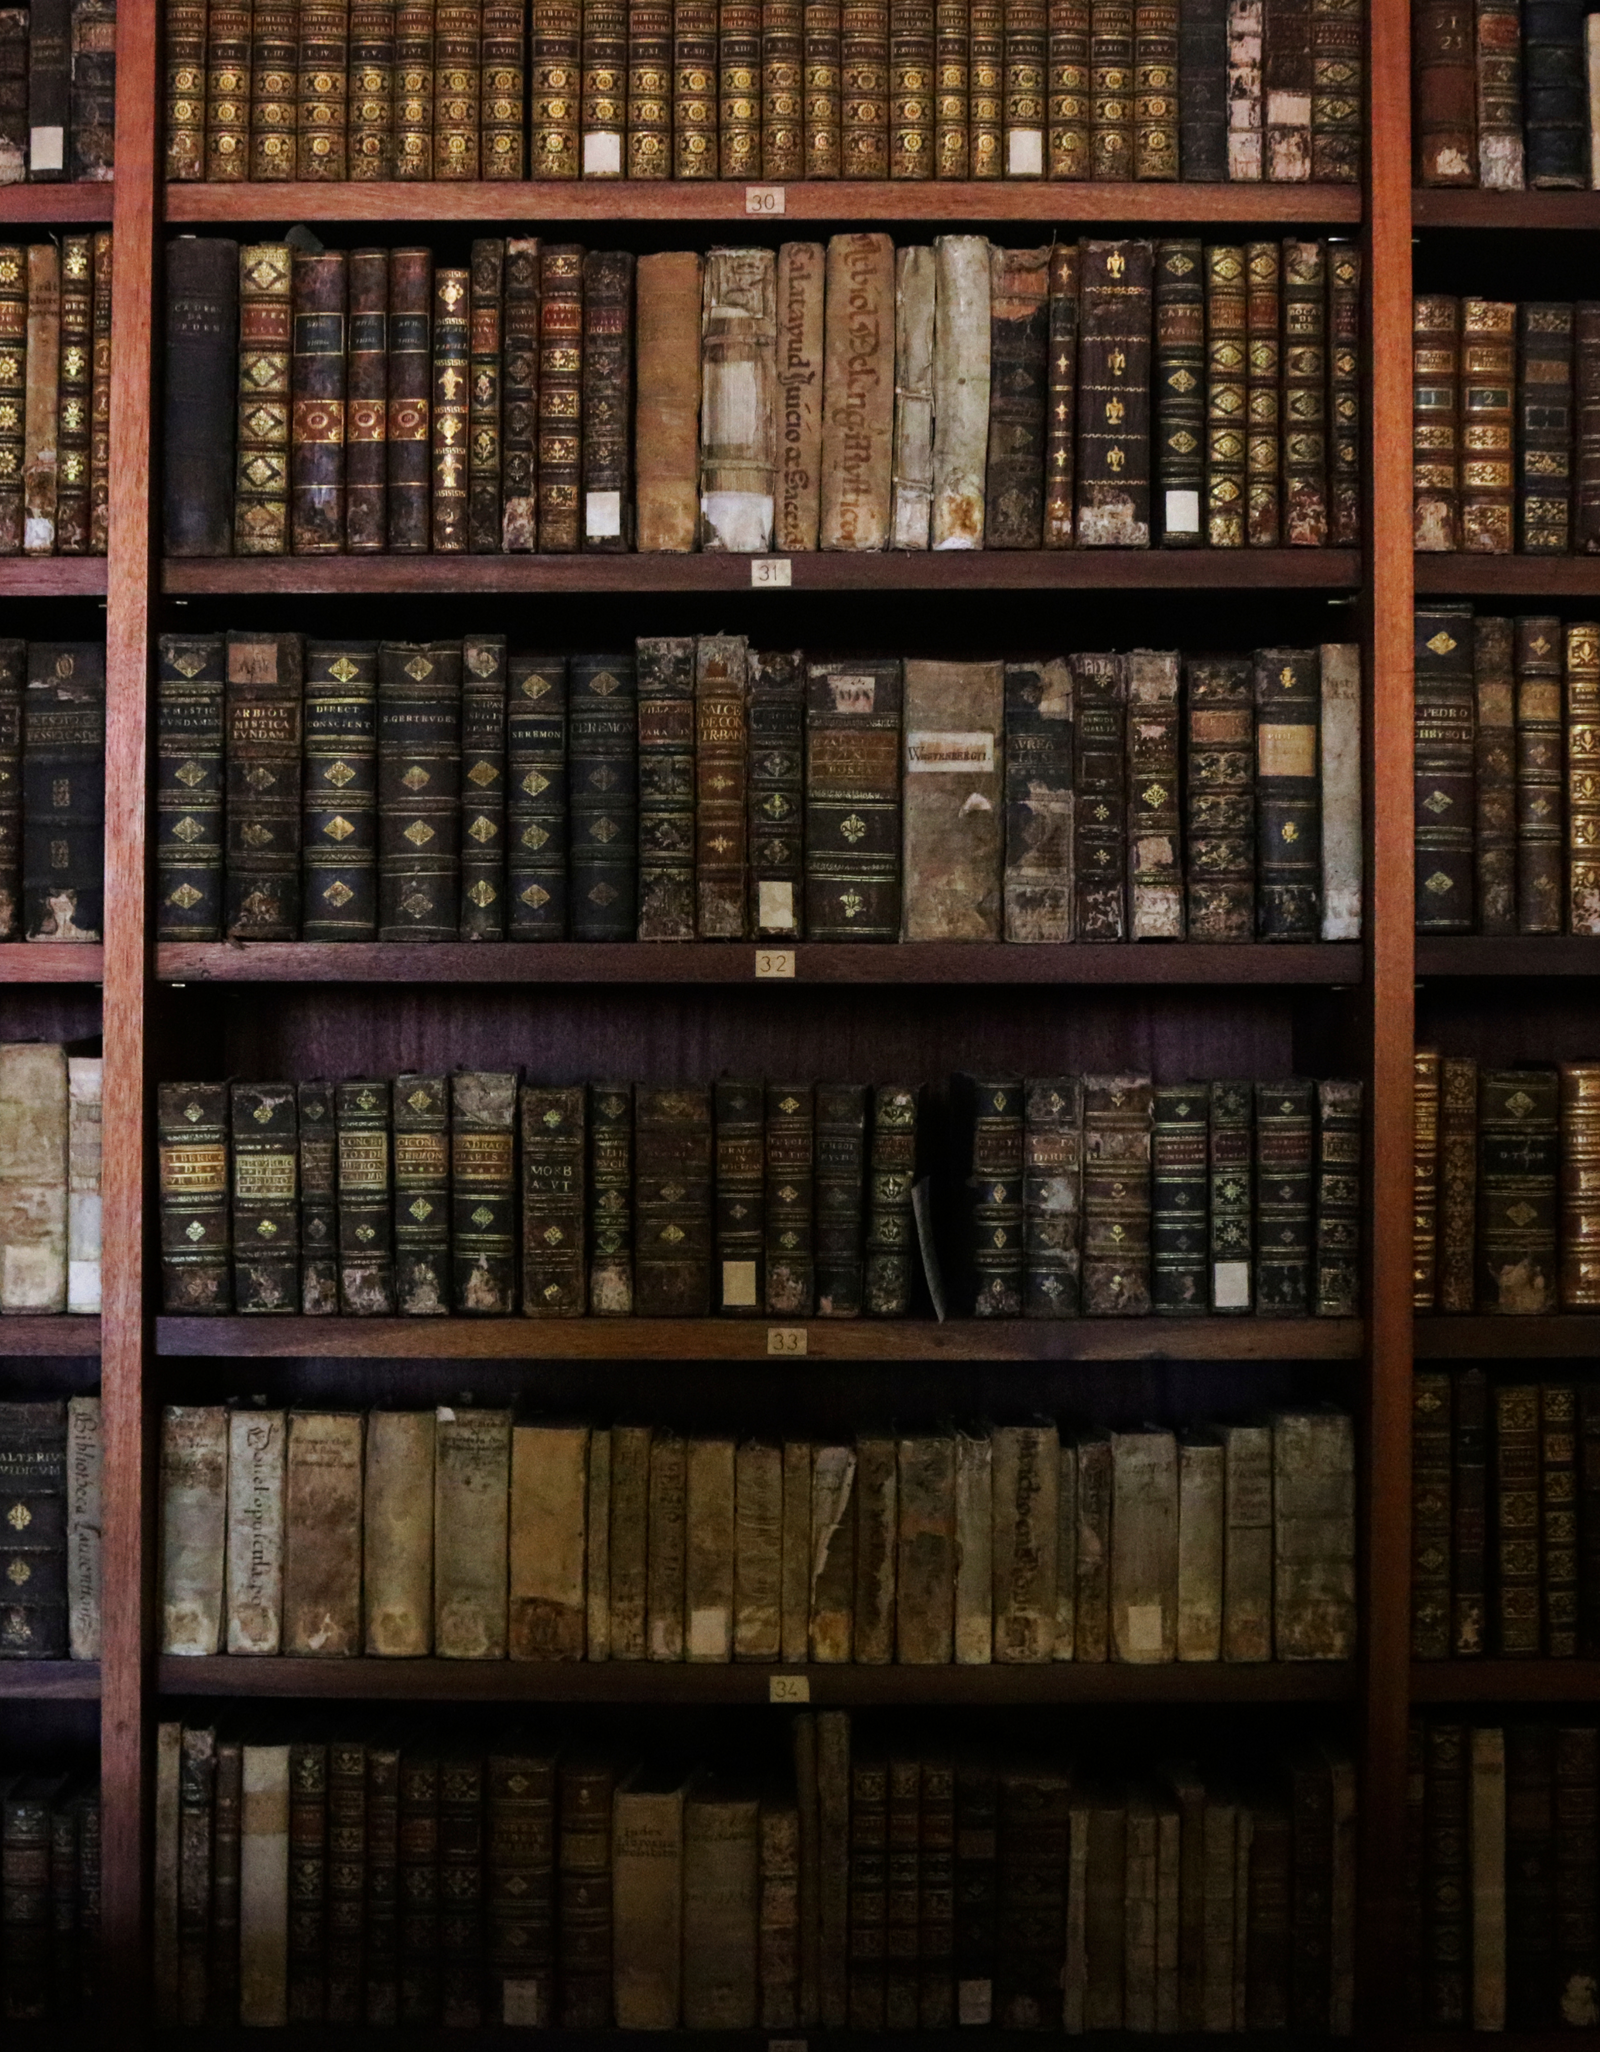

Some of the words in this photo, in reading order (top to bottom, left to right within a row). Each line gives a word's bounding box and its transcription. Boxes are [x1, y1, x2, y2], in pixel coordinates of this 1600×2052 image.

[752, 193, 776, 212] 30
[1484, 391, 1495, 405] 2
[759, 564, 778, 582] 31
[234, 708, 288, 718] ARBIOL
[702, 704, 741, 716] SALCE
[1423, 707, 1468, 718] PEDRO
[234, 720, 289, 729] MISTICA
[760, 954, 787, 973] 32
[342, 1150, 366, 1159] TOS
[773, 1332, 798, 1351] 33
[774, 1680, 799, 1699] 34
